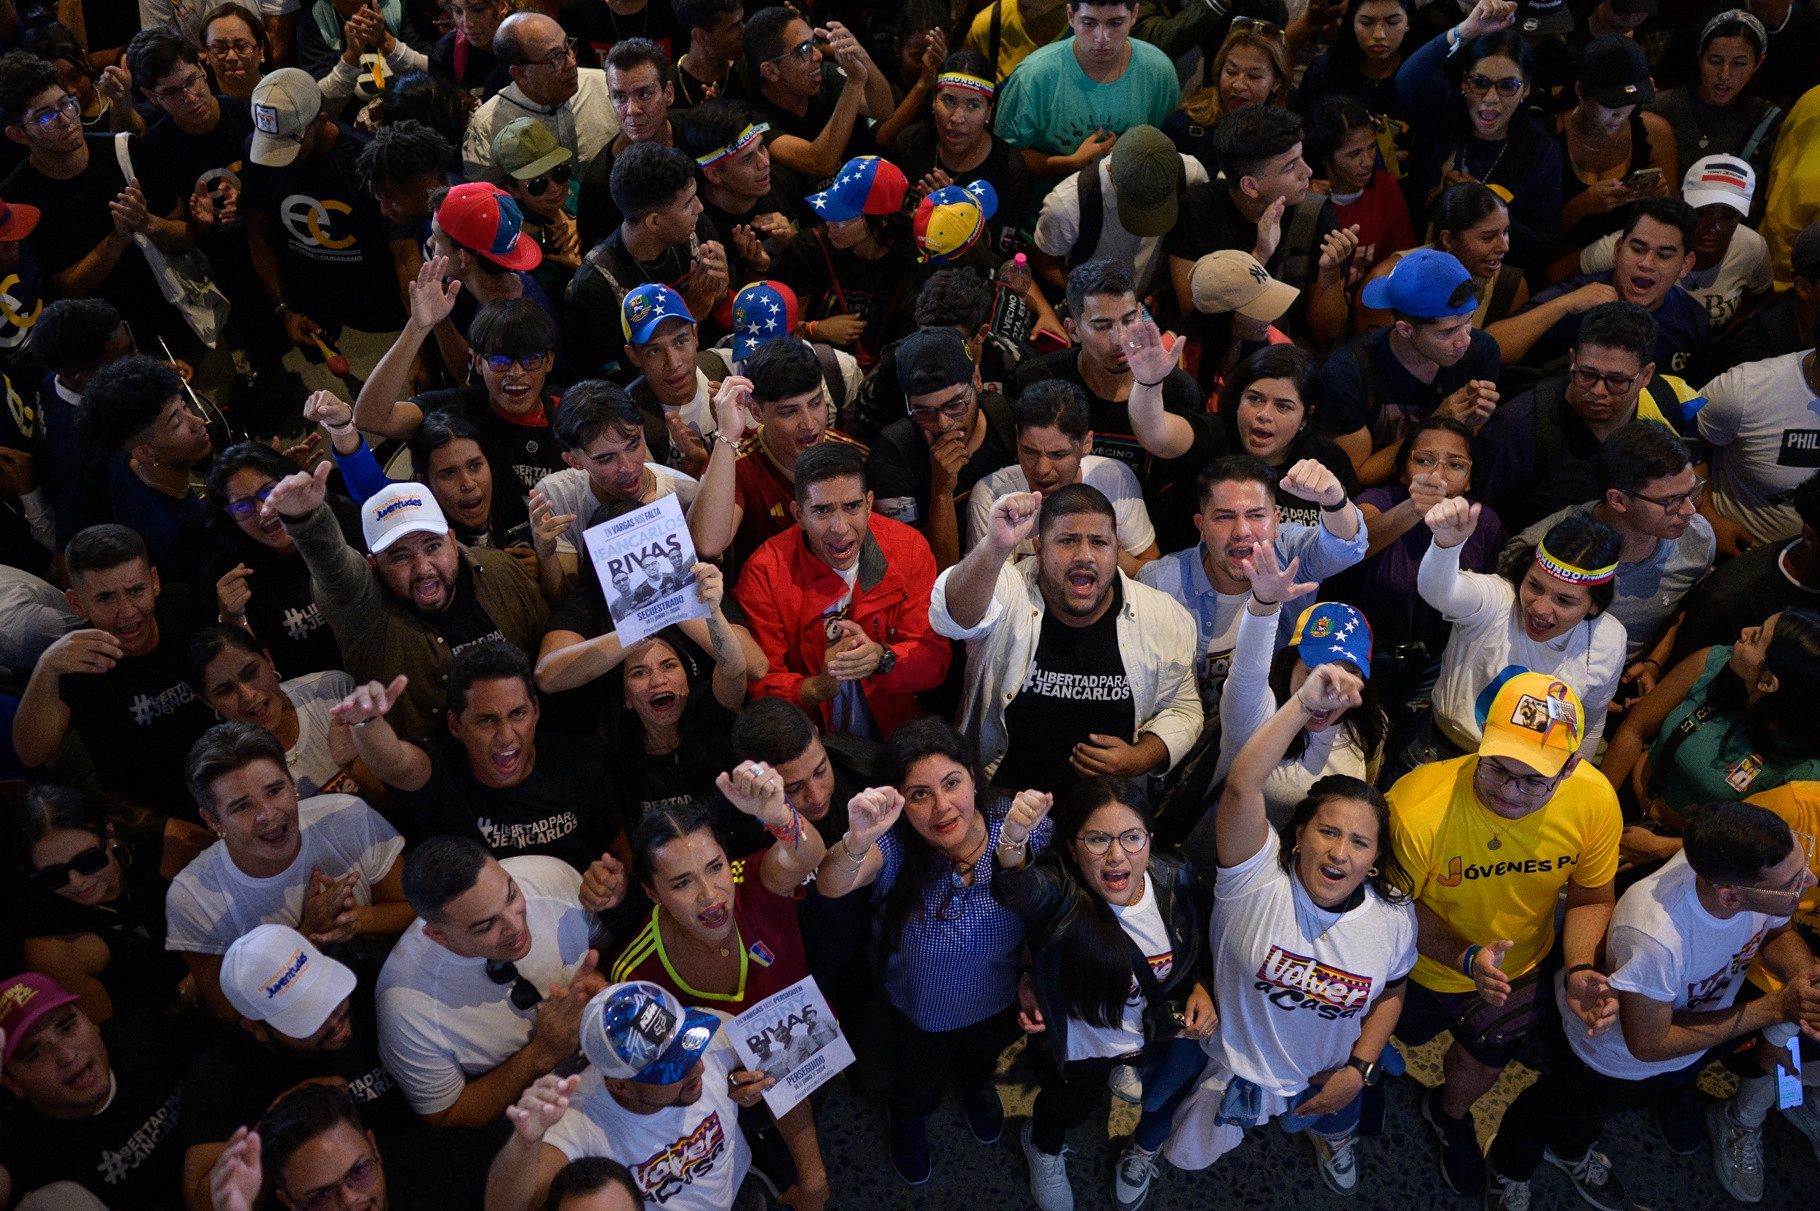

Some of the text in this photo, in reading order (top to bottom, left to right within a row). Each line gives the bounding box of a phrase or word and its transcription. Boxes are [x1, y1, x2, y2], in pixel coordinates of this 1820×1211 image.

[1248, 264, 1268, 285] NY
[1003, 294, 1017, 329] VECINO
[1012, 296, 1026, 340] OTA, EST
[1787, 433, 1820, 449] PHIL
[376, 498, 422, 521] Juventudes
[612, 517, 635, 534] VARGAS
[645, 507, 662, 521] FALTA
[1275, 505, 1320, 520] TADPAR
[592, 514, 685, 563] JEANCARLOS
[608, 534, 681, 575] RIVAS
[1538, 547, 1581, 580] DMUNDO
[637, 594, 684, 621] SECUESTRADO
[1033, 681, 1131, 701] JEANCARLOS
[490, 818, 578, 849] JEANCARLOS
[266, 952, 308, 998] Juventudes
[1265, 949, 1367, 1007] Volver
[742, 1005, 764, 1022] VARGAS
[773, 985, 804, 1004] PERSIGUEN
[745, 994, 805, 1038] JOHNY
[1254, 979, 1360, 1021] a Casa
[786, 1055, 826, 1086] PERSEGUIDO
[630, 1122, 720, 1193] Volver
